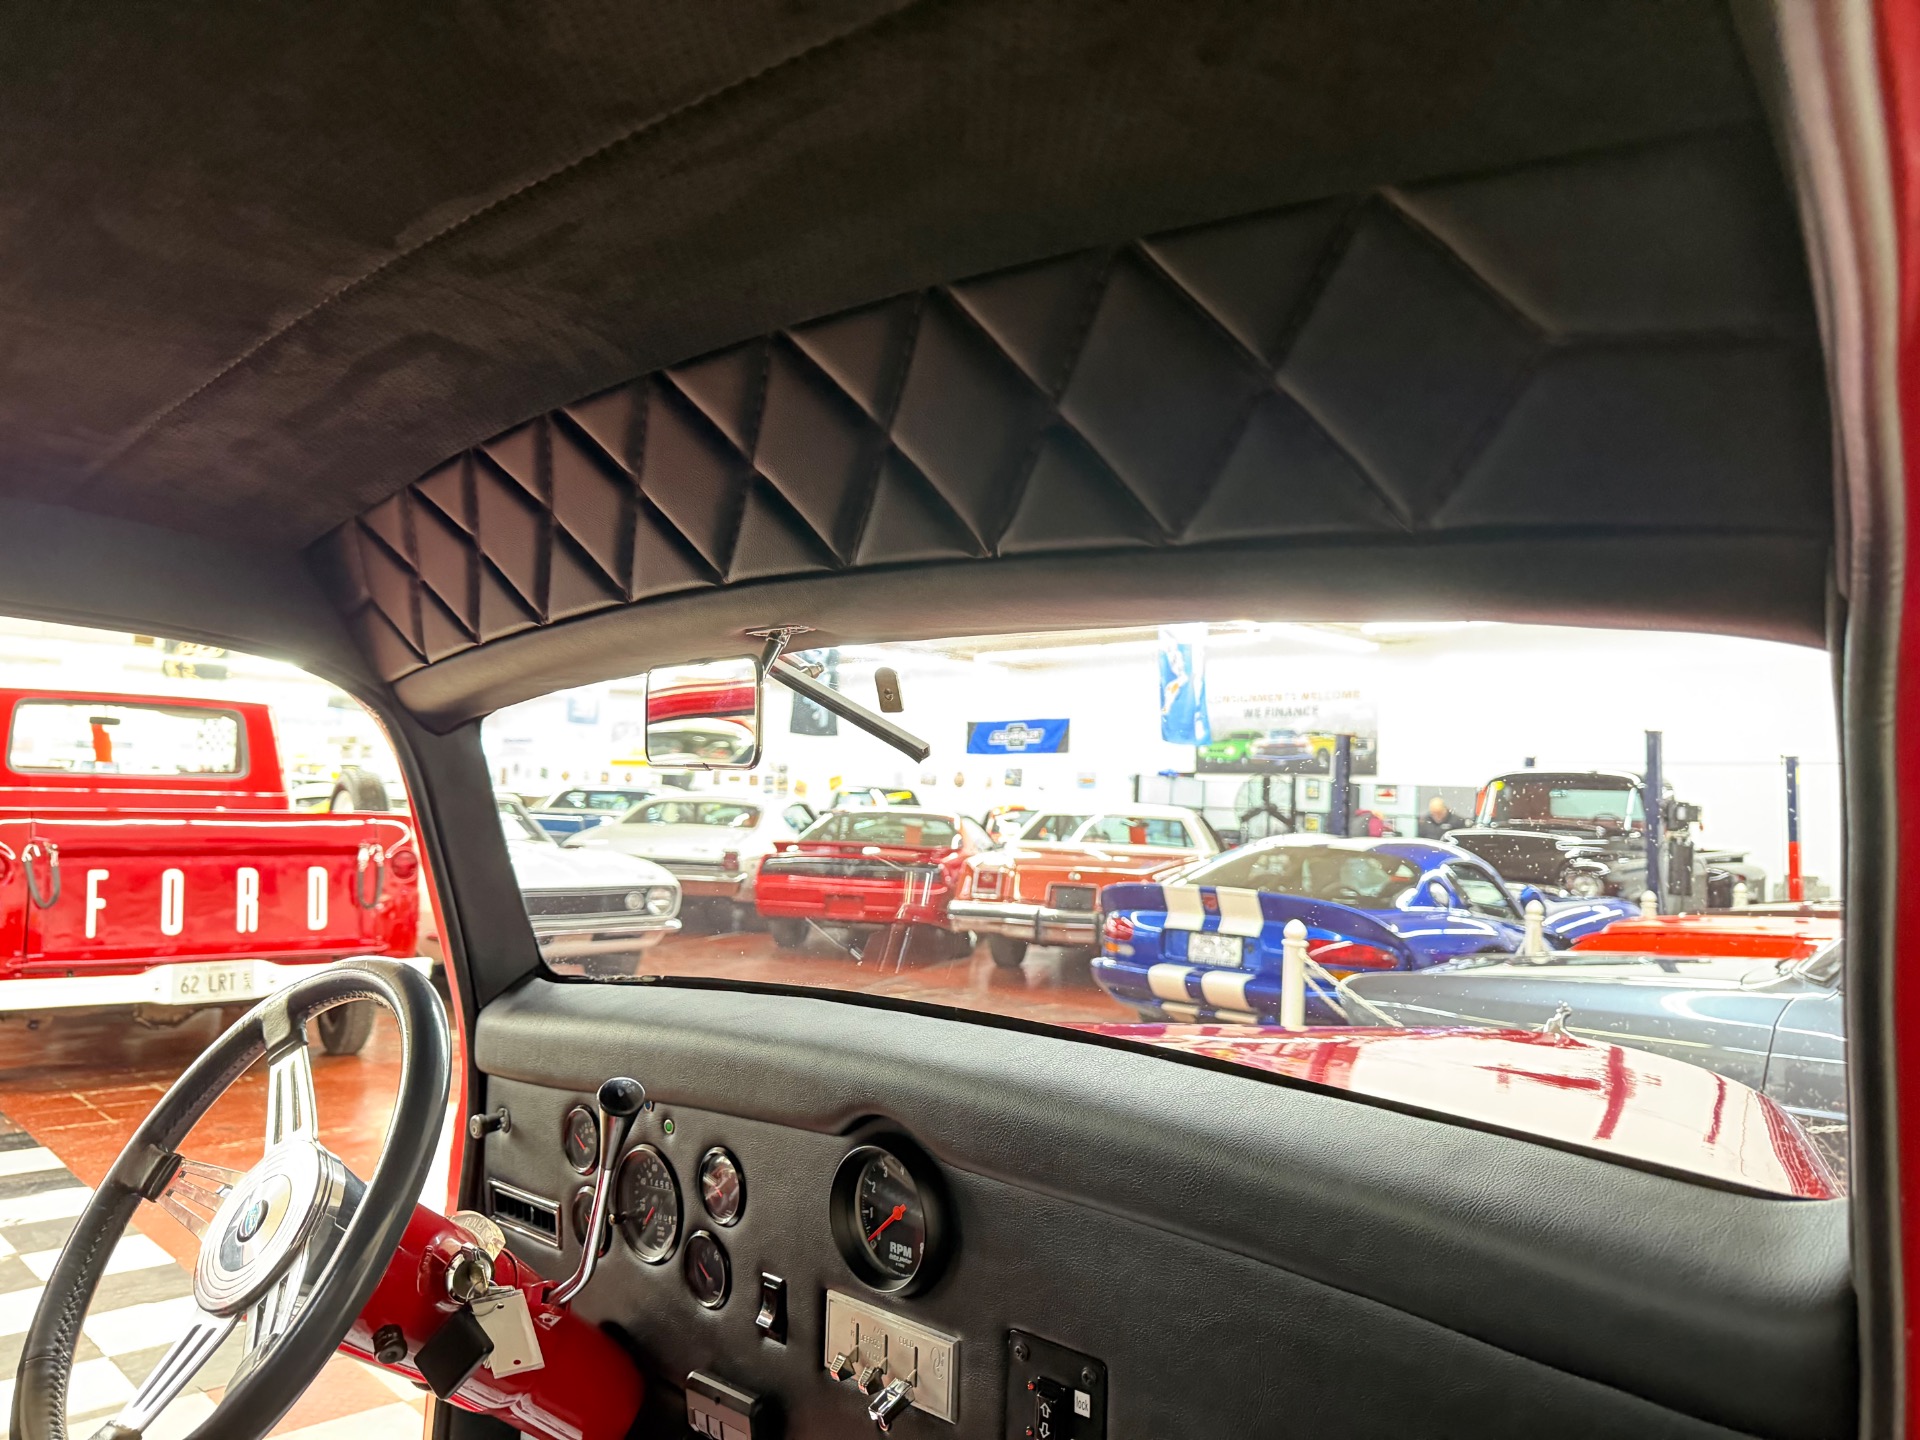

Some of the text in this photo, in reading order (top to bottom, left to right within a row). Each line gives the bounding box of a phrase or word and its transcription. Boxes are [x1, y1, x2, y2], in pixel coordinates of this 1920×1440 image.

[1301, 690, 1361, 701] WELCOME
[1243, 704, 1320, 719] WE FINANCE
[85, 866, 328, 939] FORD
[180, 974, 200, 994] 62
[208, 972, 236, 993] LRT
[890, 1241, 912, 1259] RPM
[1076, 1395, 1089, 1412] lock
